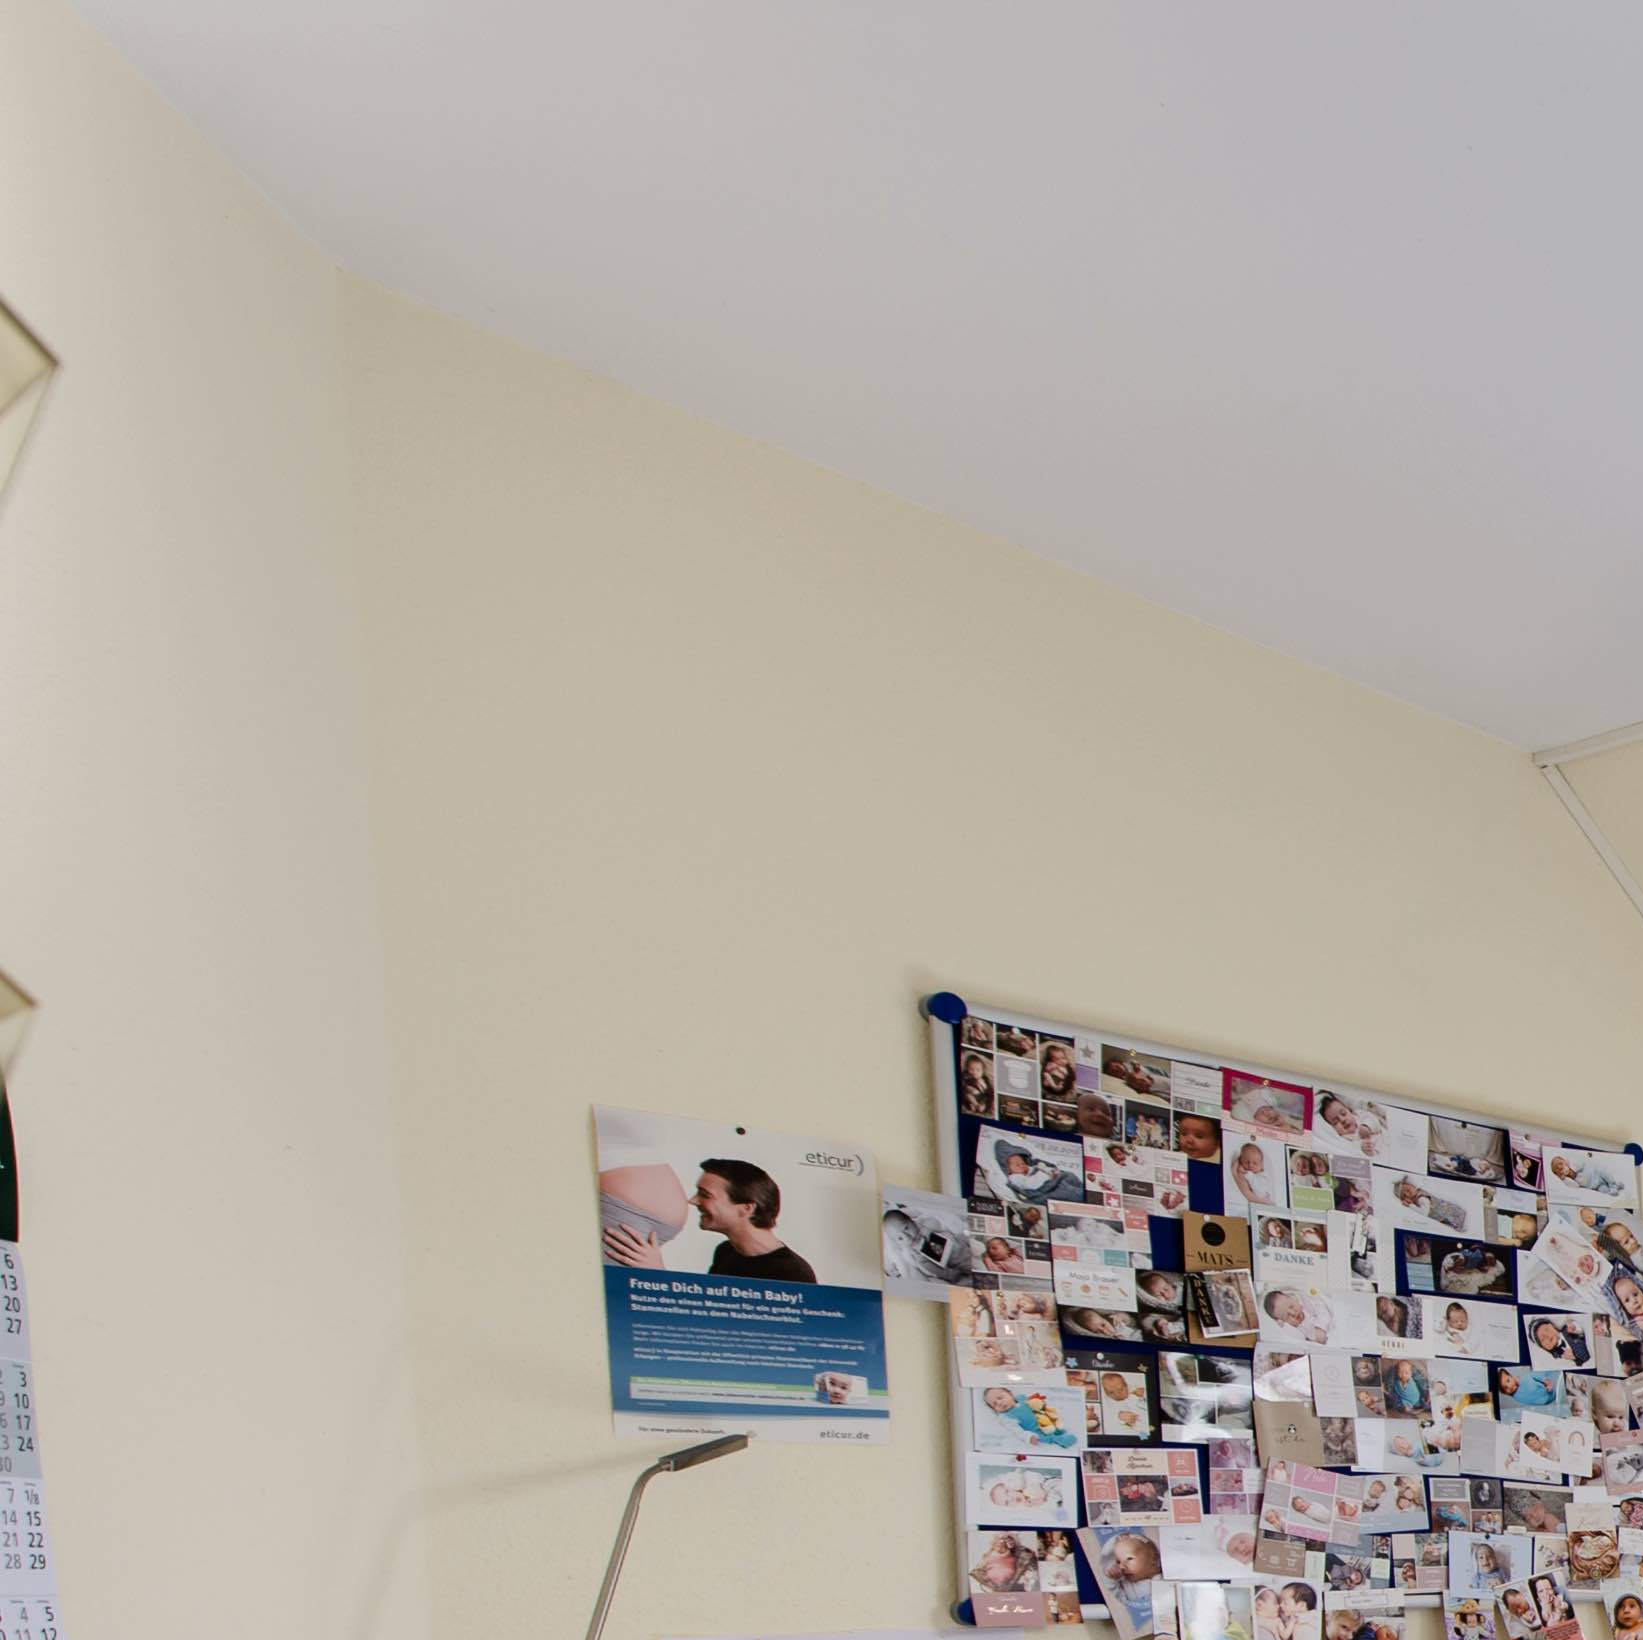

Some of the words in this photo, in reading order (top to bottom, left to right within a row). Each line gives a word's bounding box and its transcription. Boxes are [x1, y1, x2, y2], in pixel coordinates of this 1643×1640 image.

[4, 1253, 14, 1270] 6
[1197, 1251, 1235, 1266] MATS
[1274, 1252, 1314, 1266] DANKE
[0, 1274, 18, 1292] 13
[630, 1278, 669, 1292] Freue
[671, 1281, 704, 1295] Dich
[706, 1286, 728, 1297] auf
[731, 1287, 762, 1300] Dein
[764, 1290, 804, 1305] Baby!
[3, 1295, 21, 1313] 20
[7, 1316, 22, 1335] 27
[20, 1371, 27, 1388] 3
[14, 1393, 30, 1410] 10
[0, 1412, 8, 1429] 6
[16, 1415, 31, 1431] 17
[820, 1429, 870, 1440] eticur.de
[0, 1435, 10, 1450] 3
[18, 1436, 34, 1452] 24
[7, 1488, 15, 1504] 7
[2, 1510, 18, 1526] 14
[26, 1511, 42, 1527] 15
[3, 1532, 19, 1548] 21
[28, 1532, 44, 1548] 22
[5, 1553, 22, 1569] 28
[30, 1554, 46, 1570] 29
[20, 1606, 29, 1622] 4
[45, 1606, 55, 1622] 5
